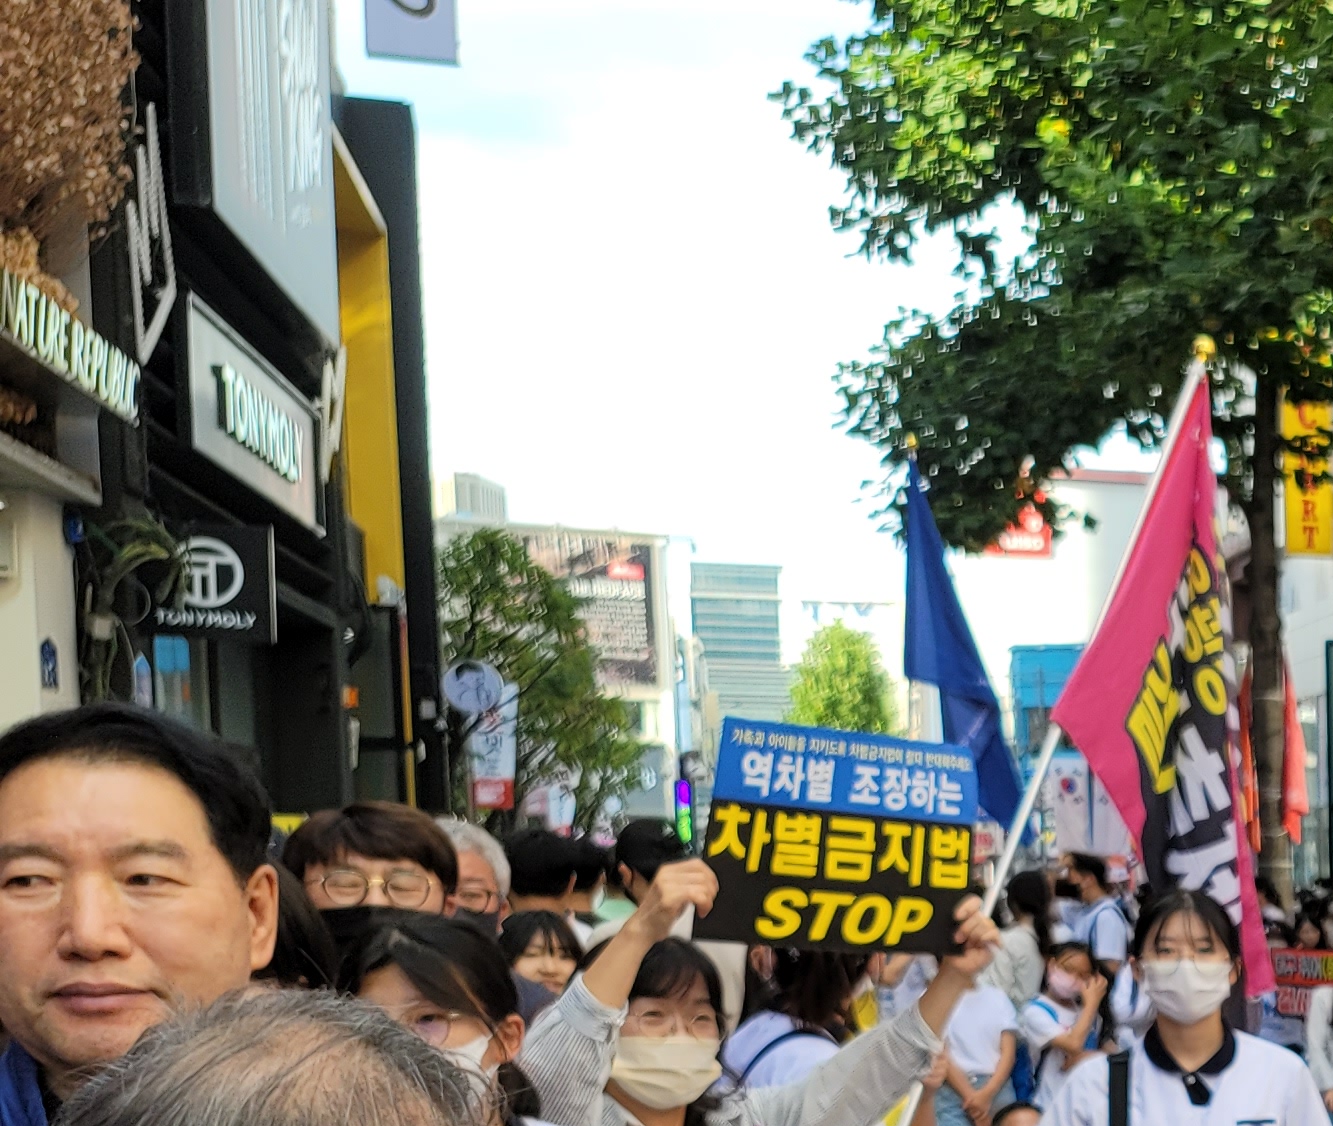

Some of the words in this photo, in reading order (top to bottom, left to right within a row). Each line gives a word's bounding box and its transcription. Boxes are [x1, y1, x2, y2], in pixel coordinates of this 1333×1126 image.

[71, 318, 141, 428] REPUBLIC
[219, 361, 303, 483] TONYMOLY
[155, 606, 258, 631] TONYMOLY
[741, 750, 836, 804] 역차별
[848, 765, 964, 817] 조장하는
[707, 802, 972, 890] 차별금지법
[755, 886, 935, 947] STOP
